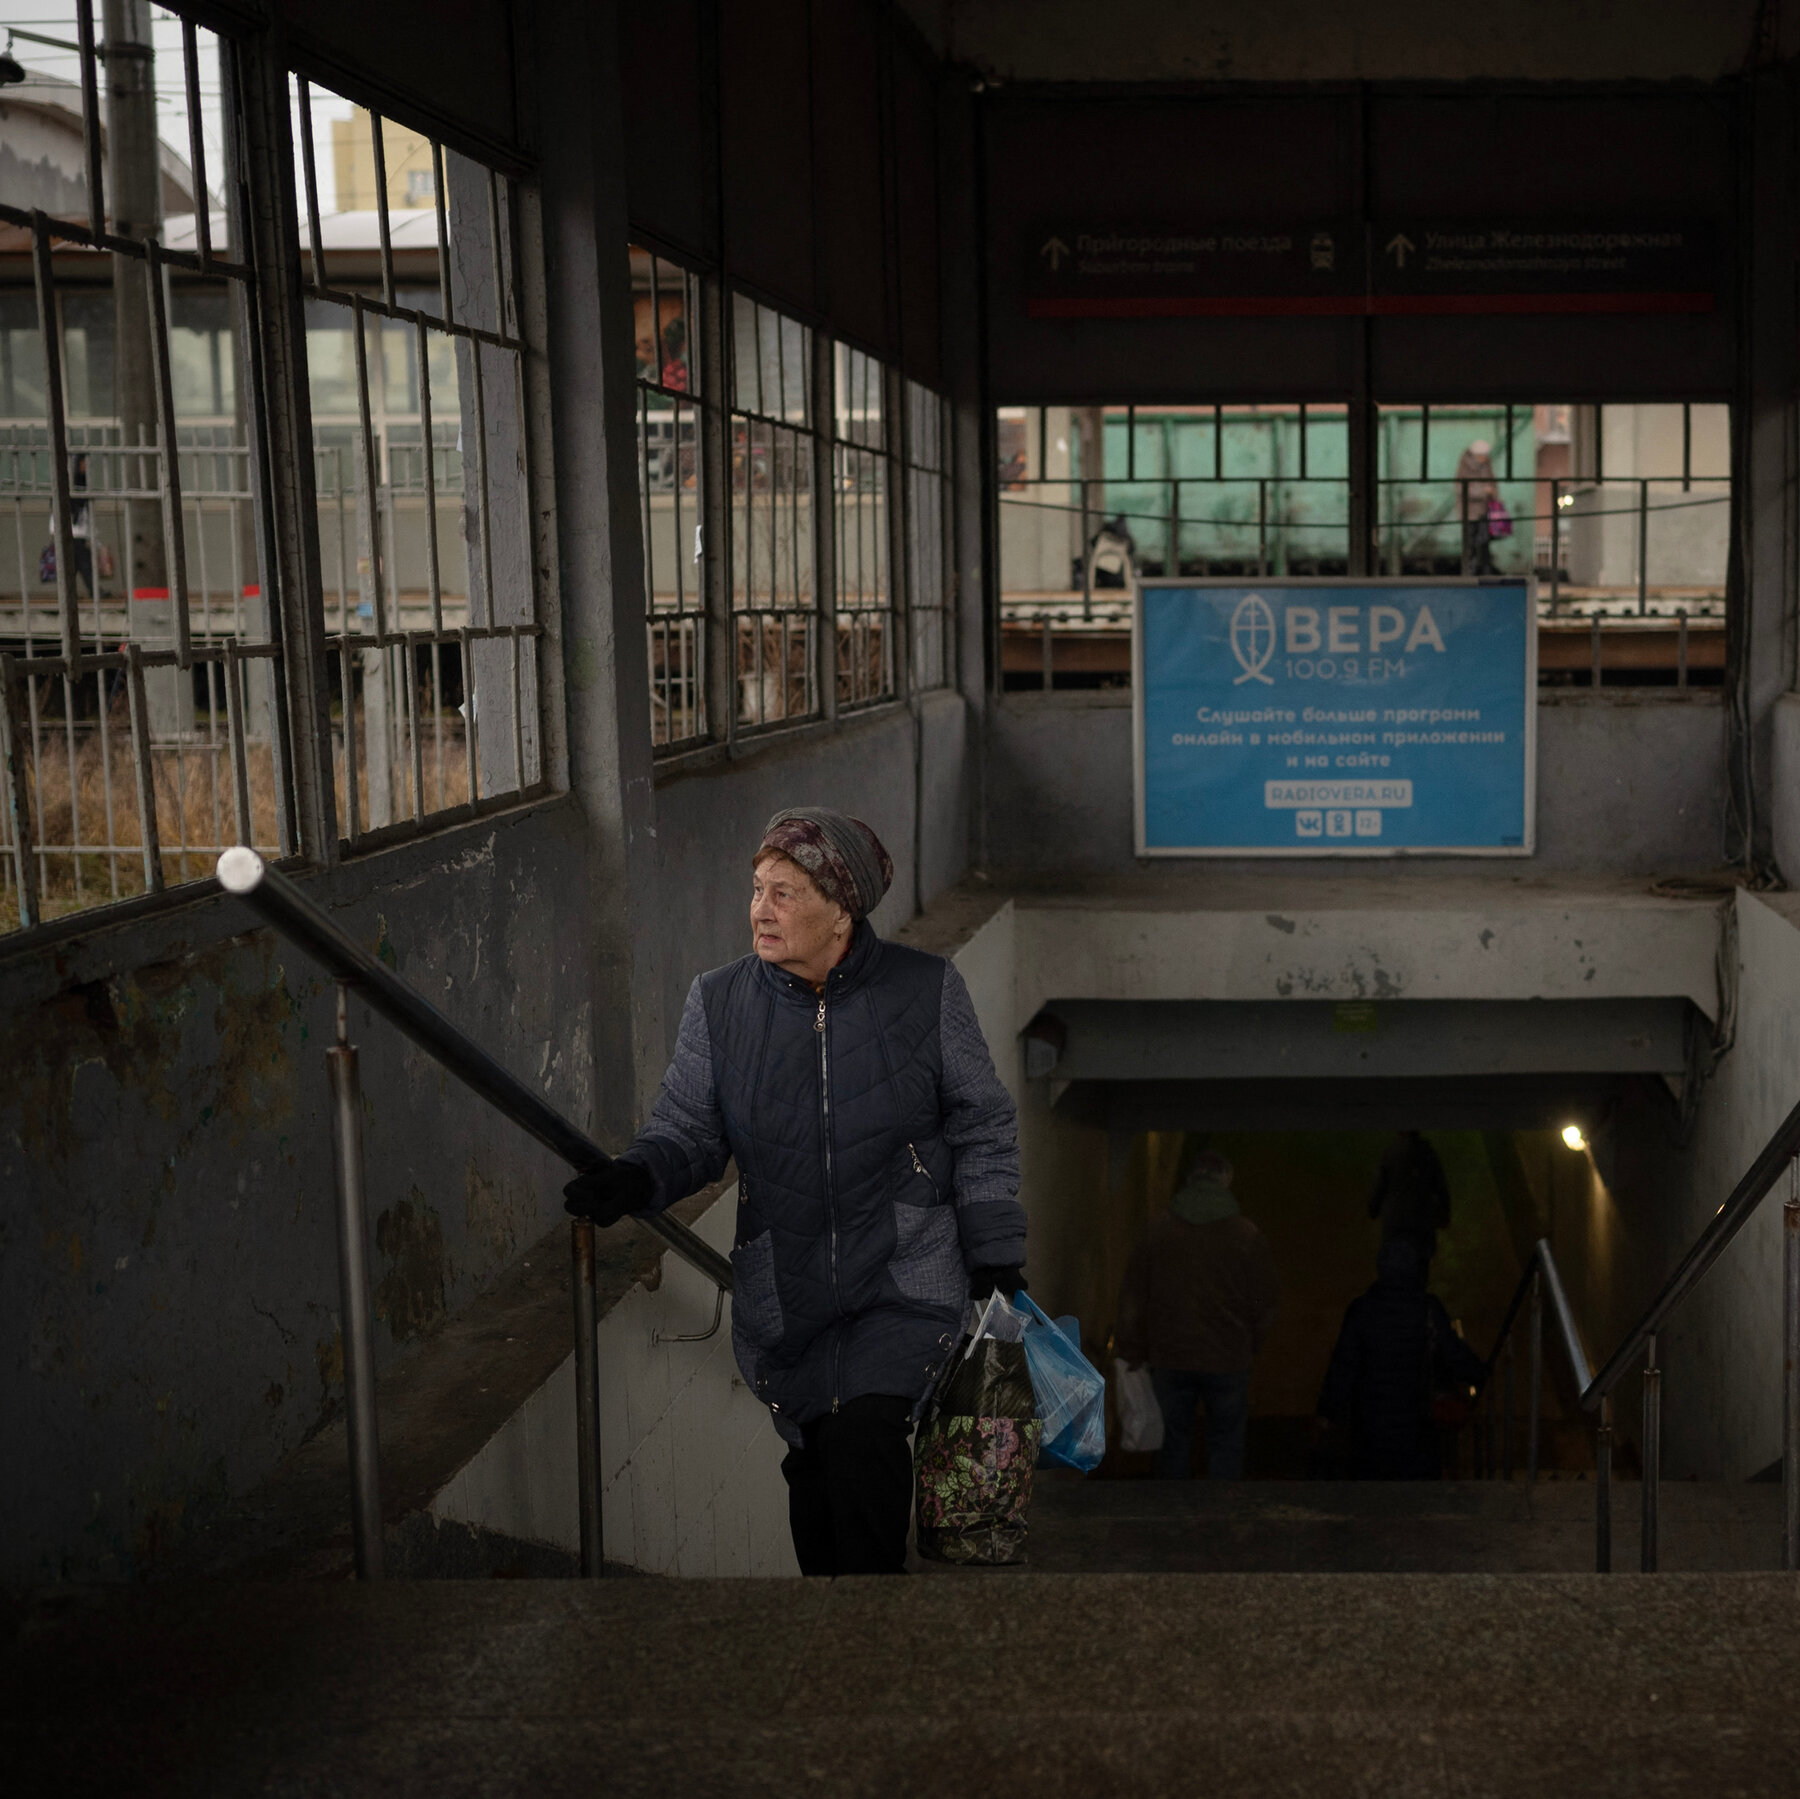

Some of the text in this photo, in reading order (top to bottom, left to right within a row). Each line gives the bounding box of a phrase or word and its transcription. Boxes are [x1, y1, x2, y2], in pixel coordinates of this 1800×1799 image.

[1222, 236, 1292, 253] поезда
[1425, 230, 1683, 252] Улица Железнодорожная
[1285, 604, 1446, 652] ВЕРА
[1285, 657, 1406, 680] 100.9 FM
[1197, 706, 1480, 726] Слушайте больше программ
[1172, 729, 1505, 748] онлайн в мобильном приложении
[1286, 751, 1391, 769] и на сайте
[1271, 786, 1406, 801] RADIOVERA.RU
